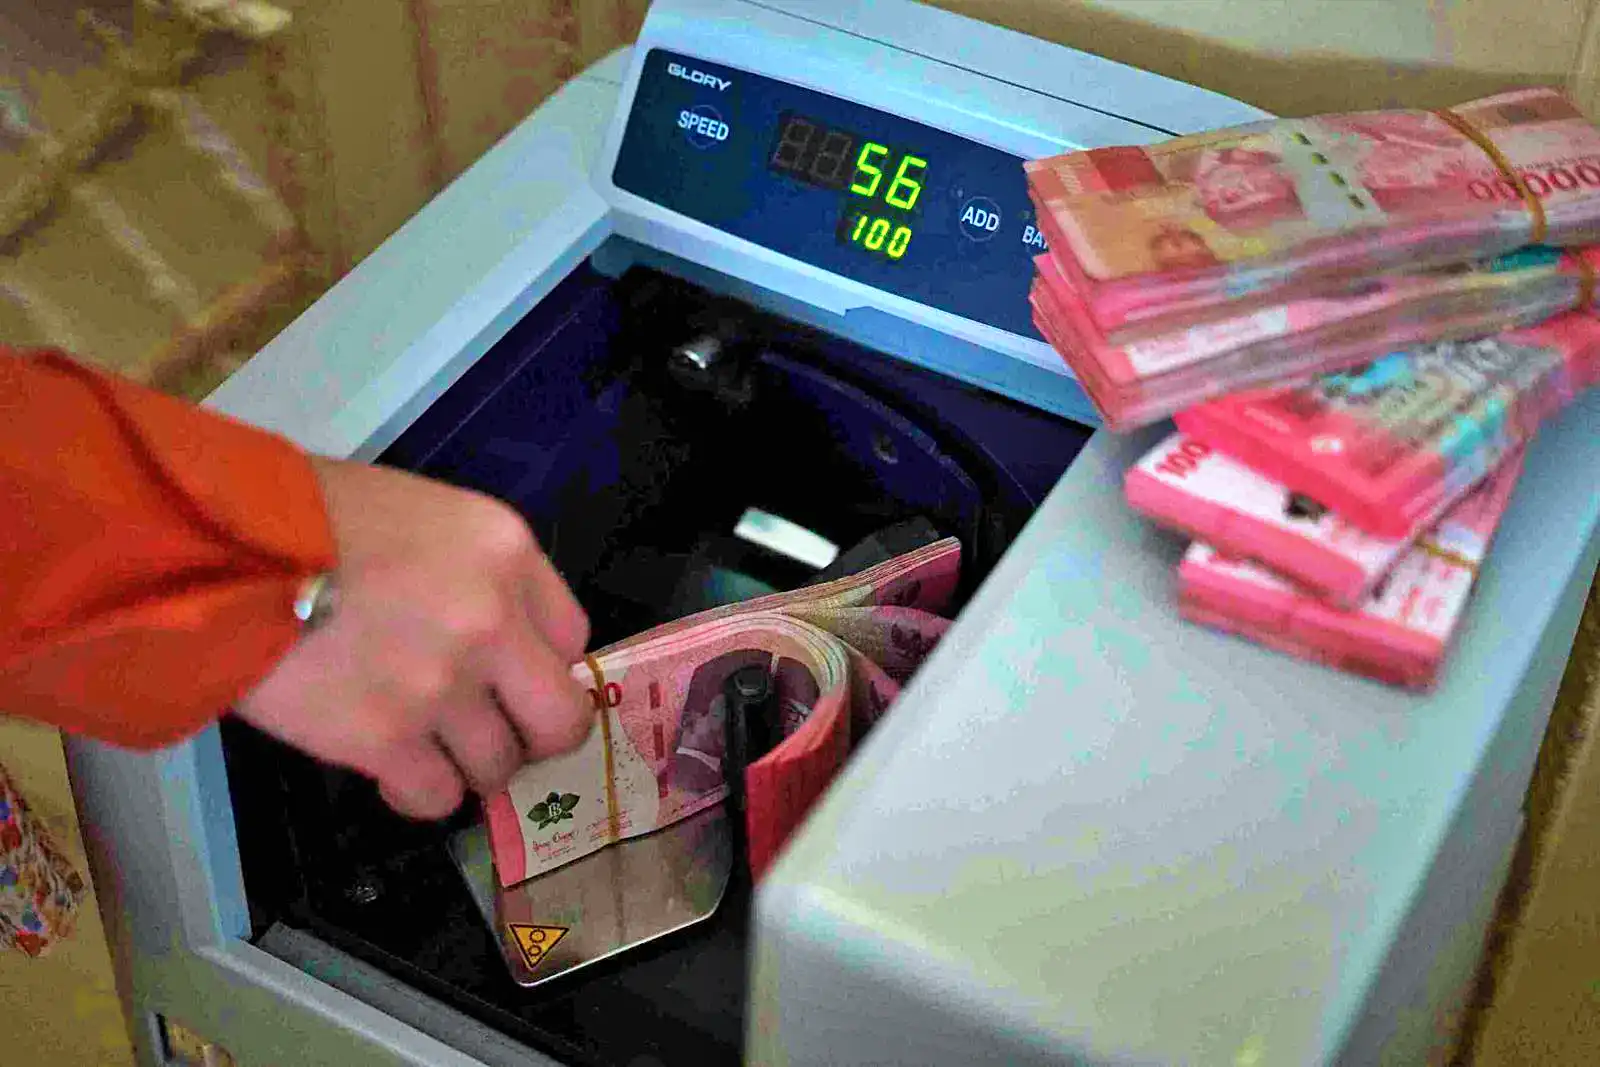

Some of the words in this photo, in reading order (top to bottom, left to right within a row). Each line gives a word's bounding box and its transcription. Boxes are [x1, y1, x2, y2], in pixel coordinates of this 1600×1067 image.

[668, 63, 732, 91] GLORY
[677, 110, 729, 141] SPEED
[850, 142, 927, 210] 56
[961, 206, 1000, 232] ADD
[852, 215, 912, 259] 100
